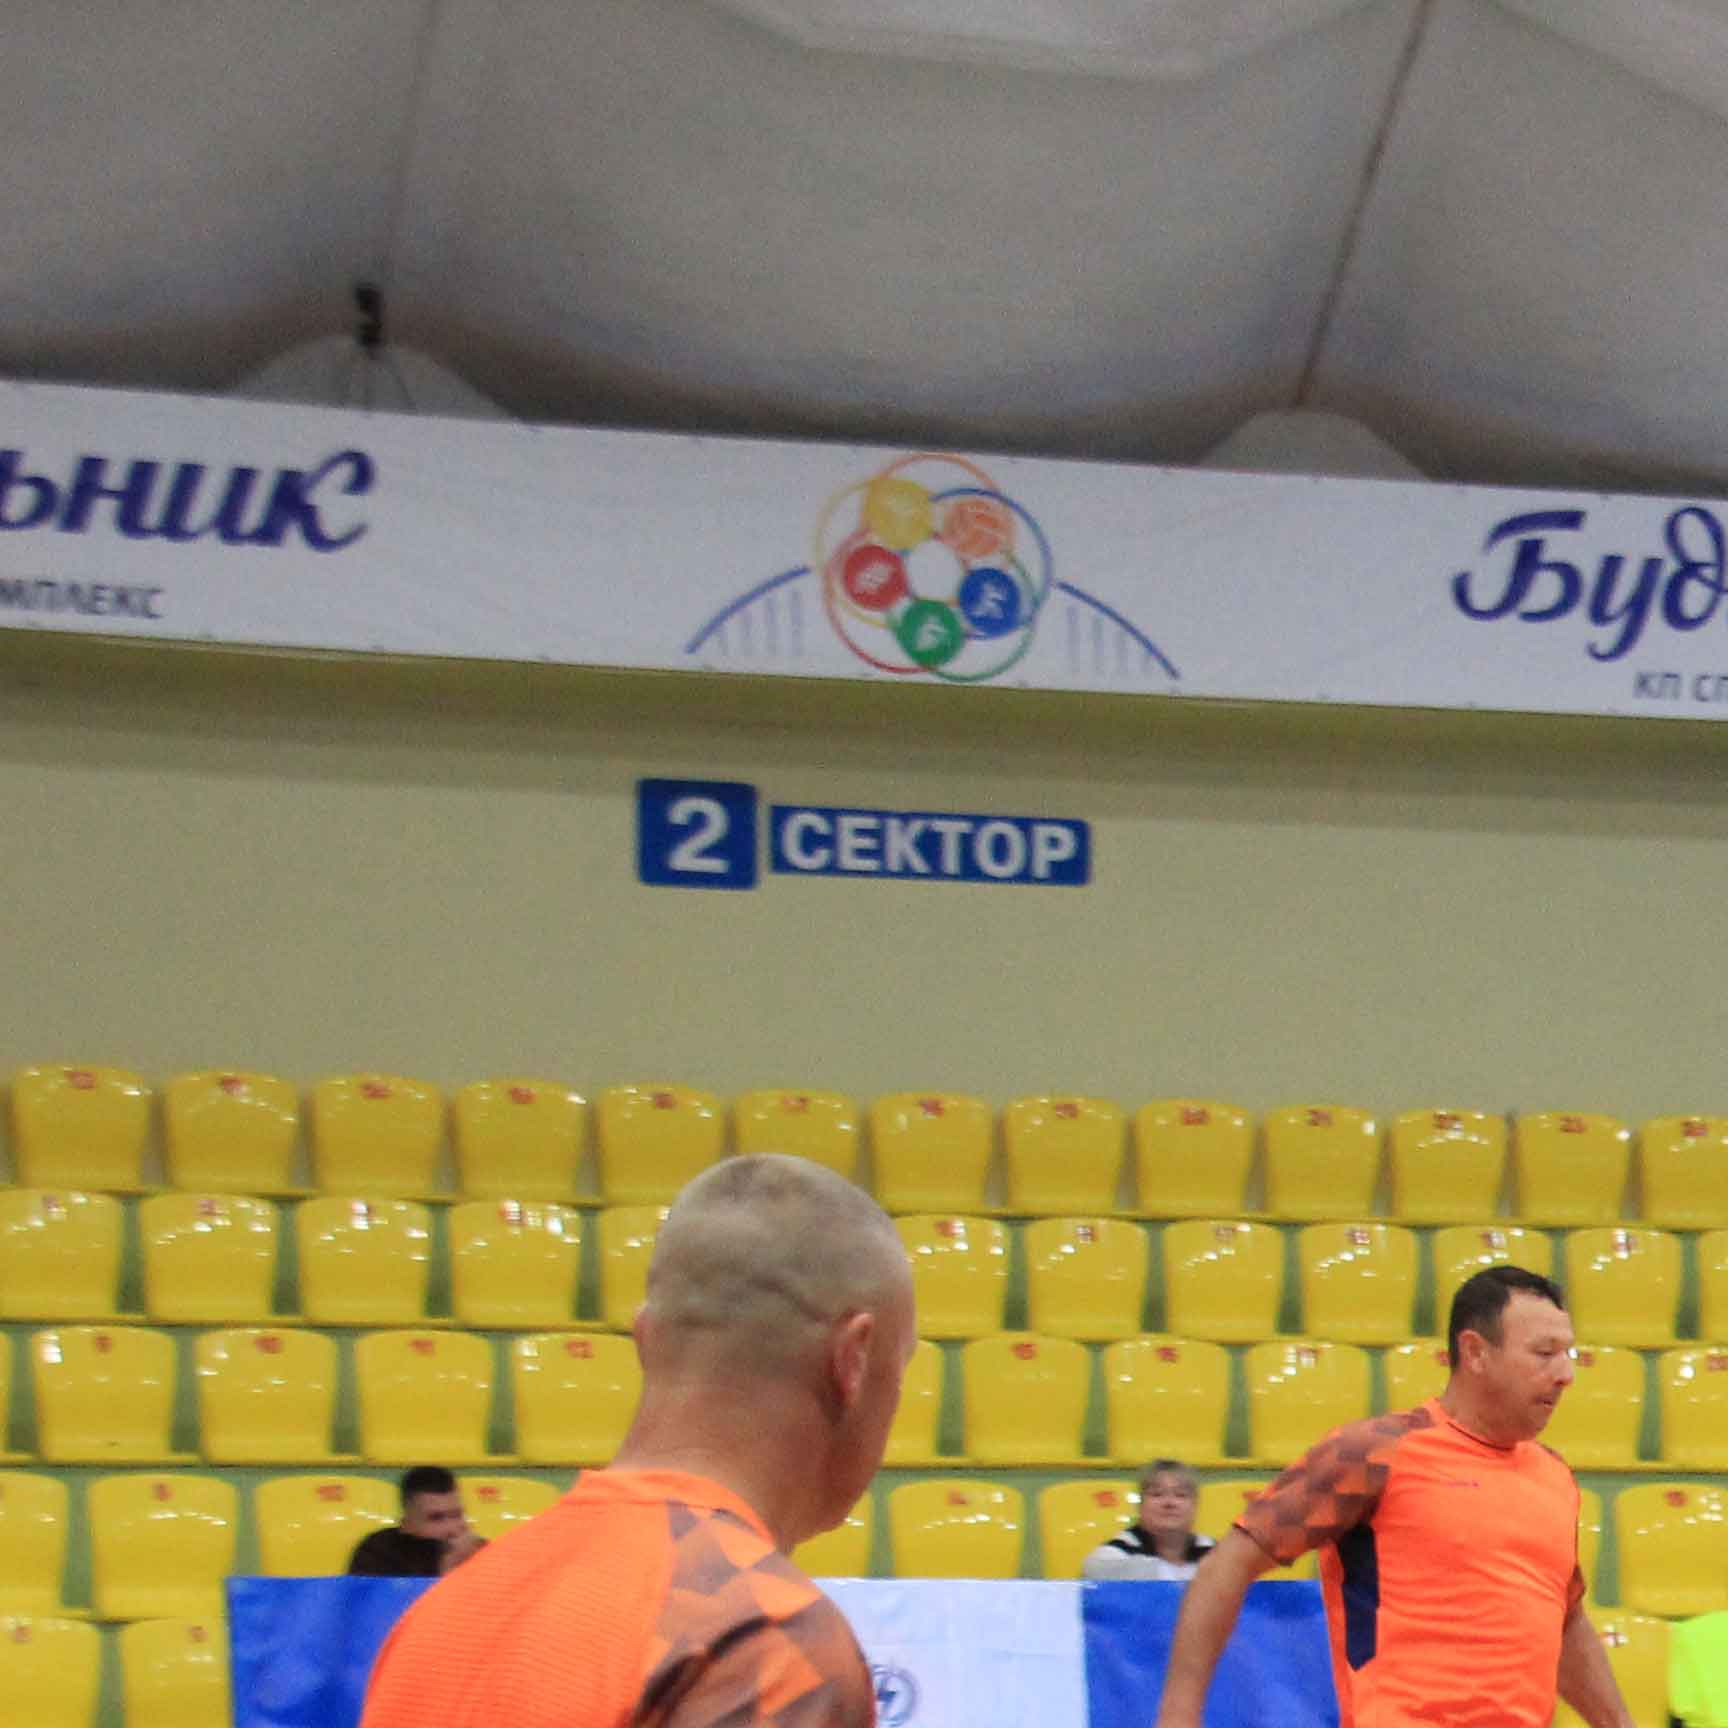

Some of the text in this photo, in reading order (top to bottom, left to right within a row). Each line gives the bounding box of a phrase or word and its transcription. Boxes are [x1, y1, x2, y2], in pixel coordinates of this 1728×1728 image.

[1634, 671, 1683, 700] КП
[667, 797, 1077, 880] 2 СЕКТОР
